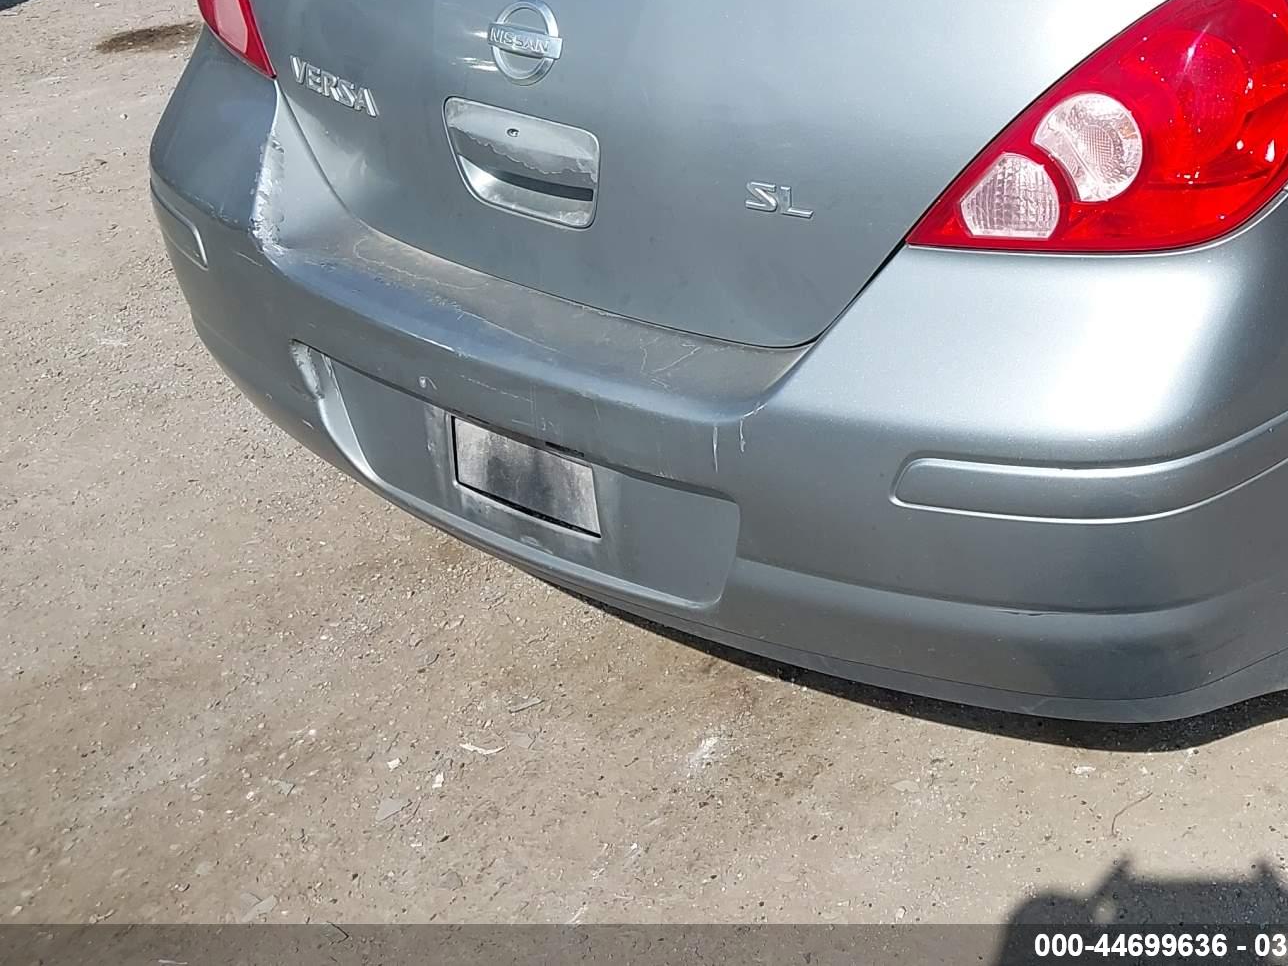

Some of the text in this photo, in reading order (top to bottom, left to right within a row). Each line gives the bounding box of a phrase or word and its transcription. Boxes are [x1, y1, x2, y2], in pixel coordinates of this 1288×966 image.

[489, 26, 550, 53] NISSAN
[290, 55, 378, 117] VERSA
[745, 181, 814, 219] SL
